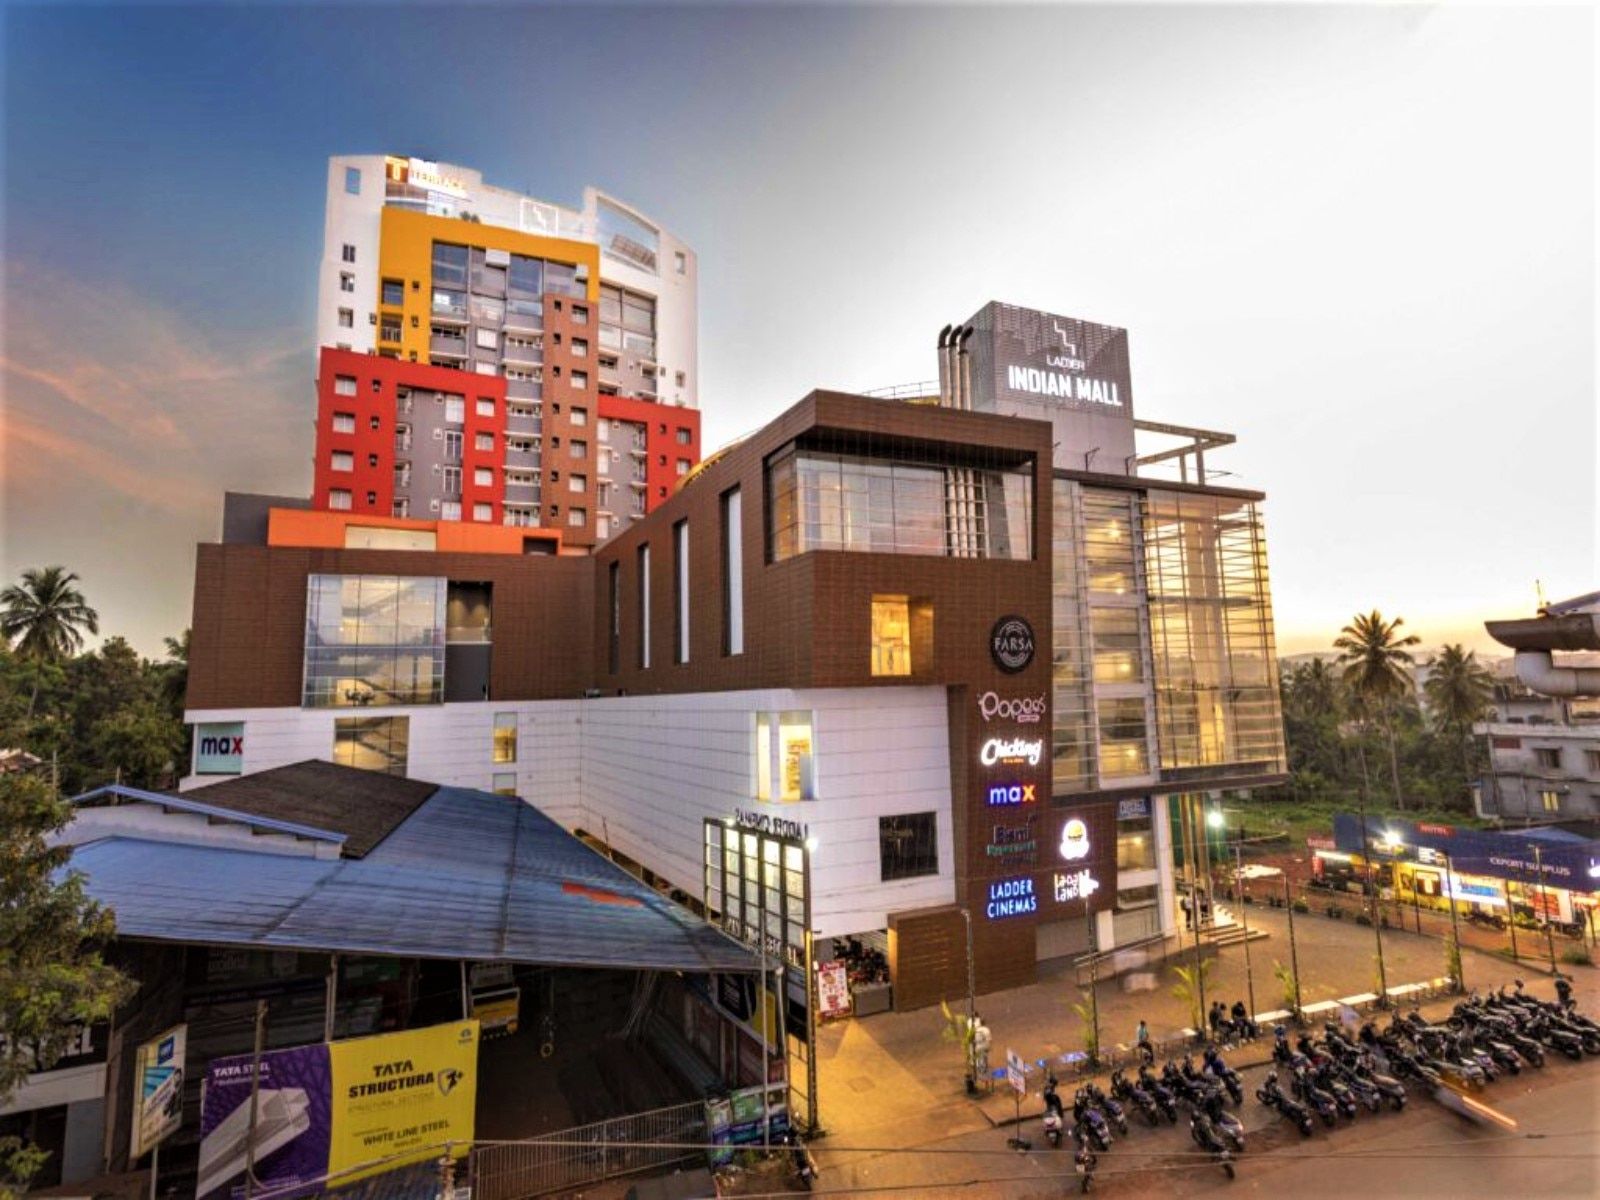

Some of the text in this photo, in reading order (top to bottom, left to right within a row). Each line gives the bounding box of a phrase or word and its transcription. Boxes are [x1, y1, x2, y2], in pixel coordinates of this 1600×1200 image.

[1046, 355, 1085, 370] LADDER
[1008, 365, 1123, 407] INDIAN MALL
[994, 636, 1034, 652] FARSA
[201, 735, 244, 756] max
[981, 738, 1043, 766] Chicking
[989, 784, 1036, 804] max
[991, 879, 1033, 900] LADDER
[986, 896, 1037, 918] CINEMAS
[213, 1061, 271, 1078] TATA STEL
[372, 1059, 414, 1077] TATA
[348, 1071, 435, 1098] STRUCTURA
[363, 1131, 395, 1147] WHITE
[396, 1125, 419, 1139] LINE
[421, 1118, 451, 1134] STEEL
